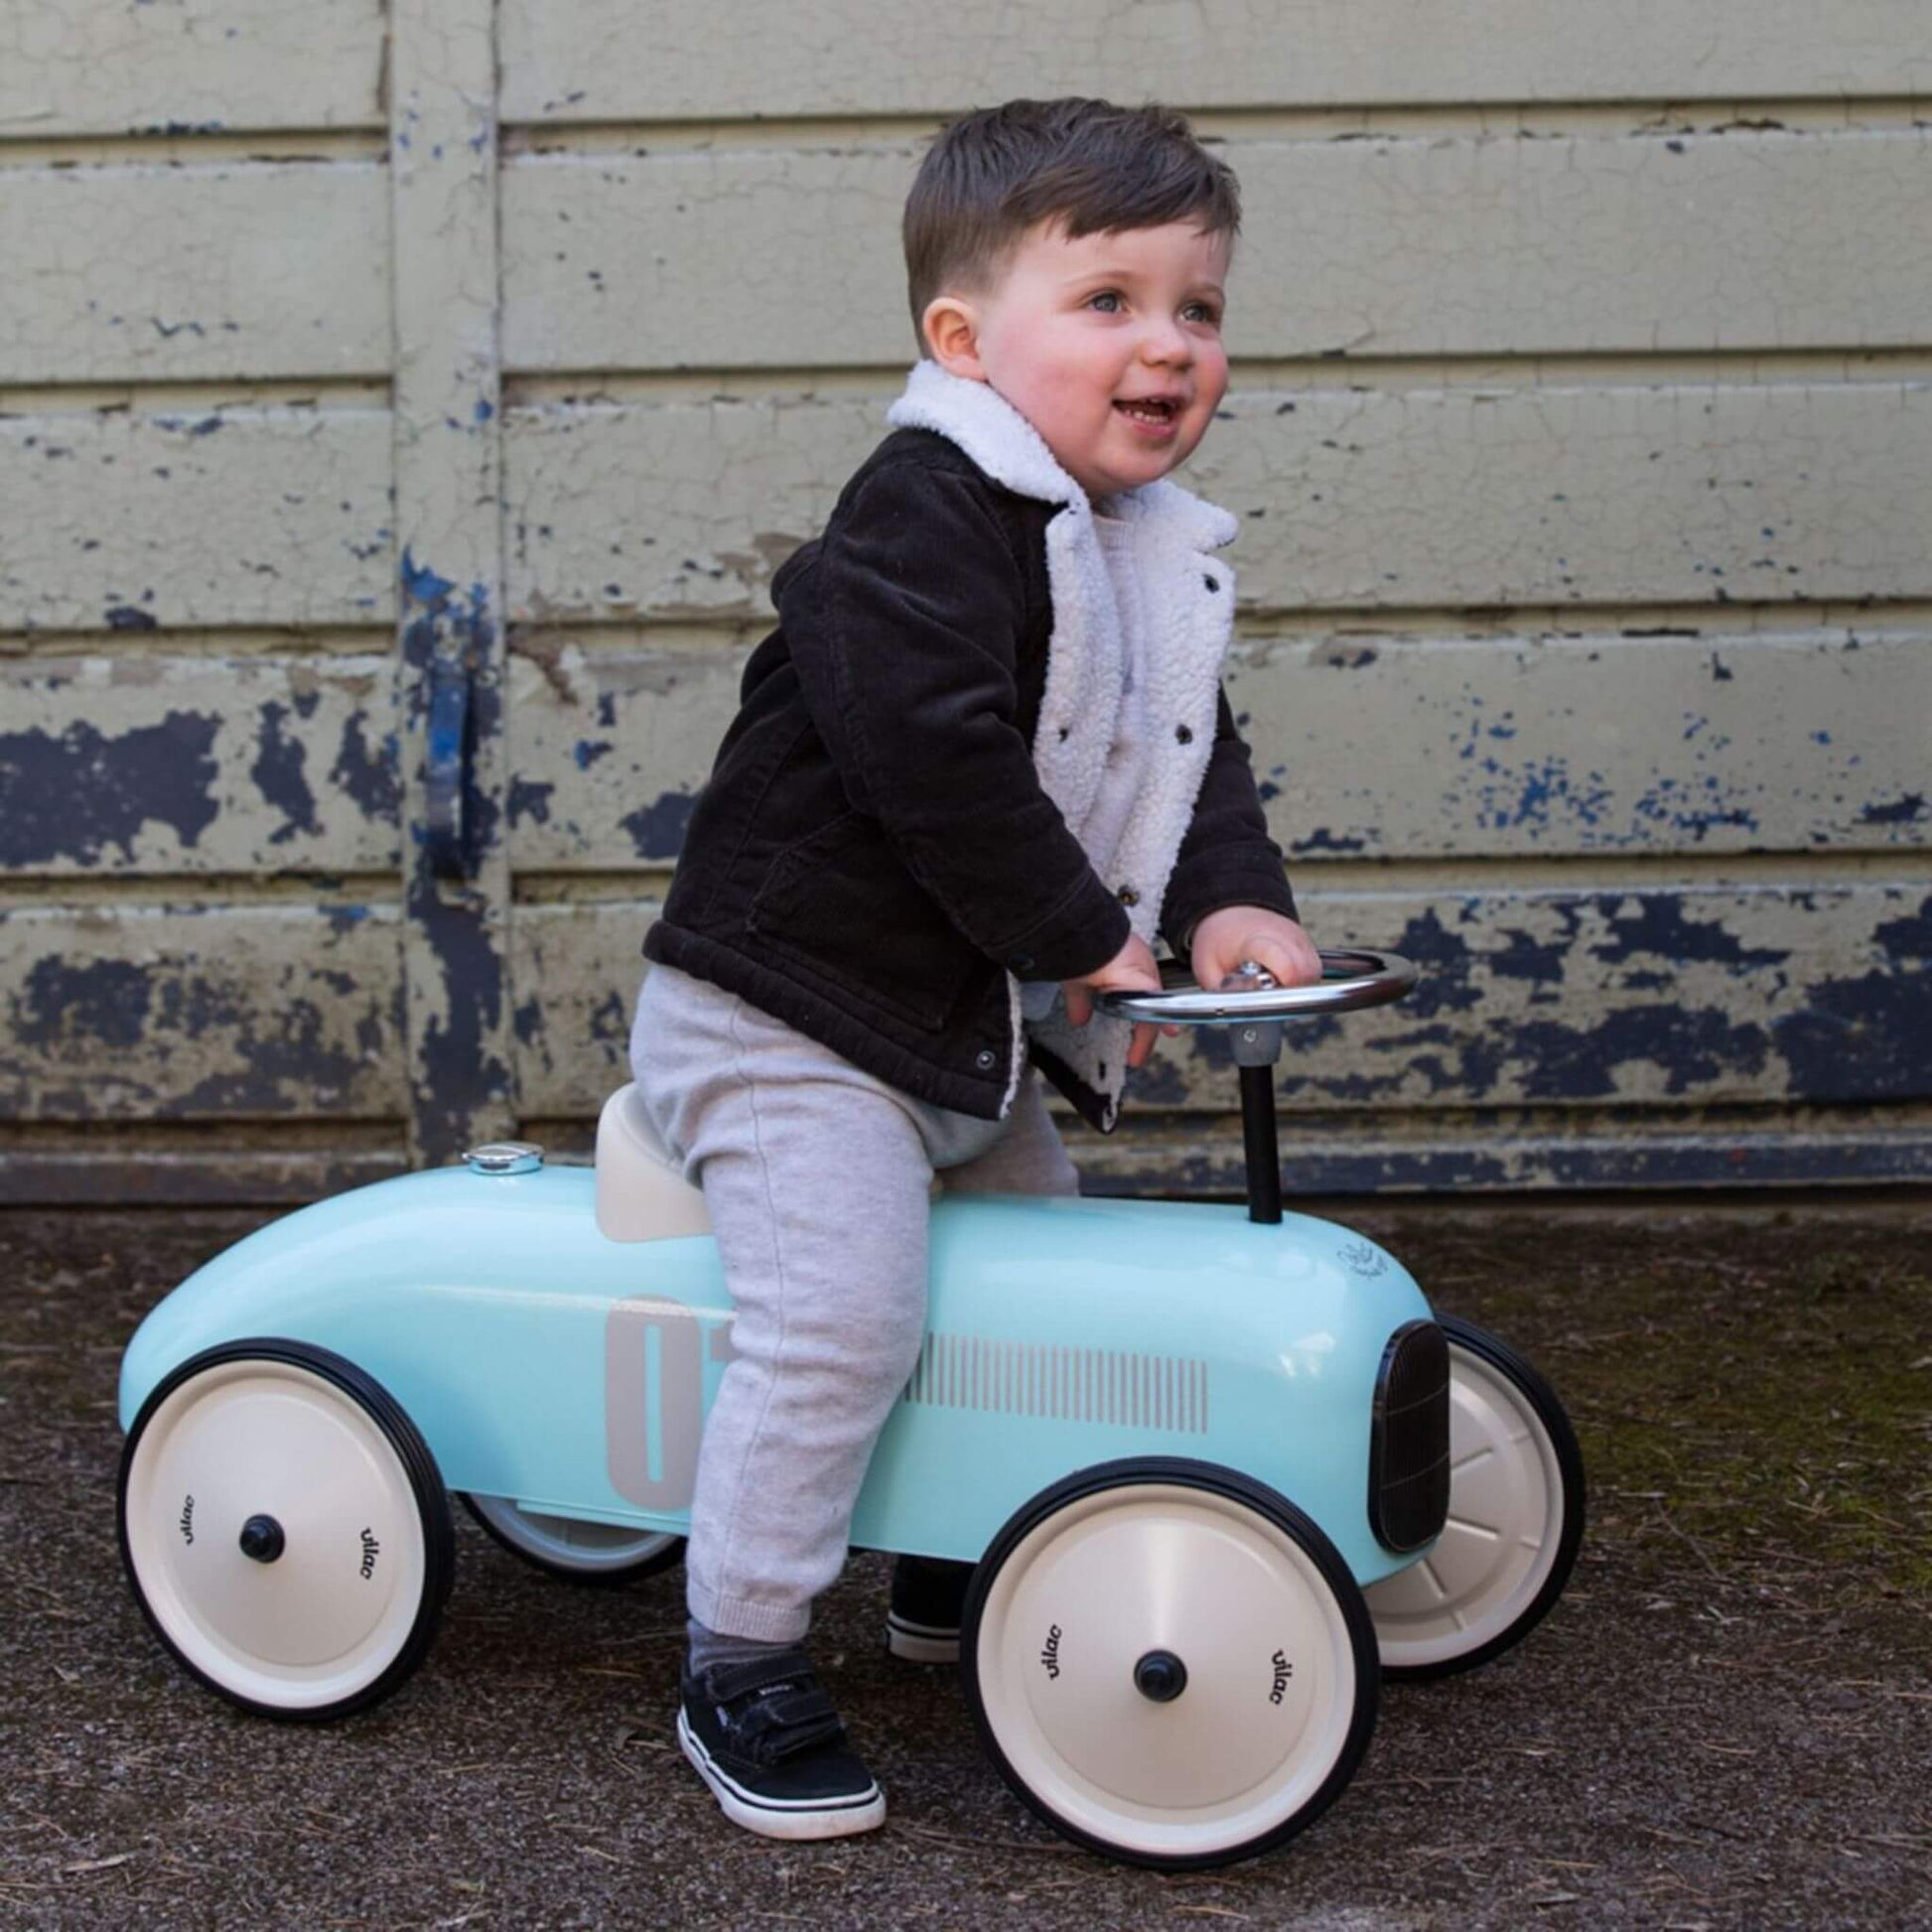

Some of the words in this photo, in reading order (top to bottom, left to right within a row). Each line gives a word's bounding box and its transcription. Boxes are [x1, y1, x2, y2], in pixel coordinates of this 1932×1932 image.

[607, 1296, 740, 1510] 0
[180, 1494, 195, 1546] vilac
[359, 1527, 380, 1581] vilac
[1040, 1623, 1062, 1681] vilac
[1269, 1649, 1293, 1706] vilac
